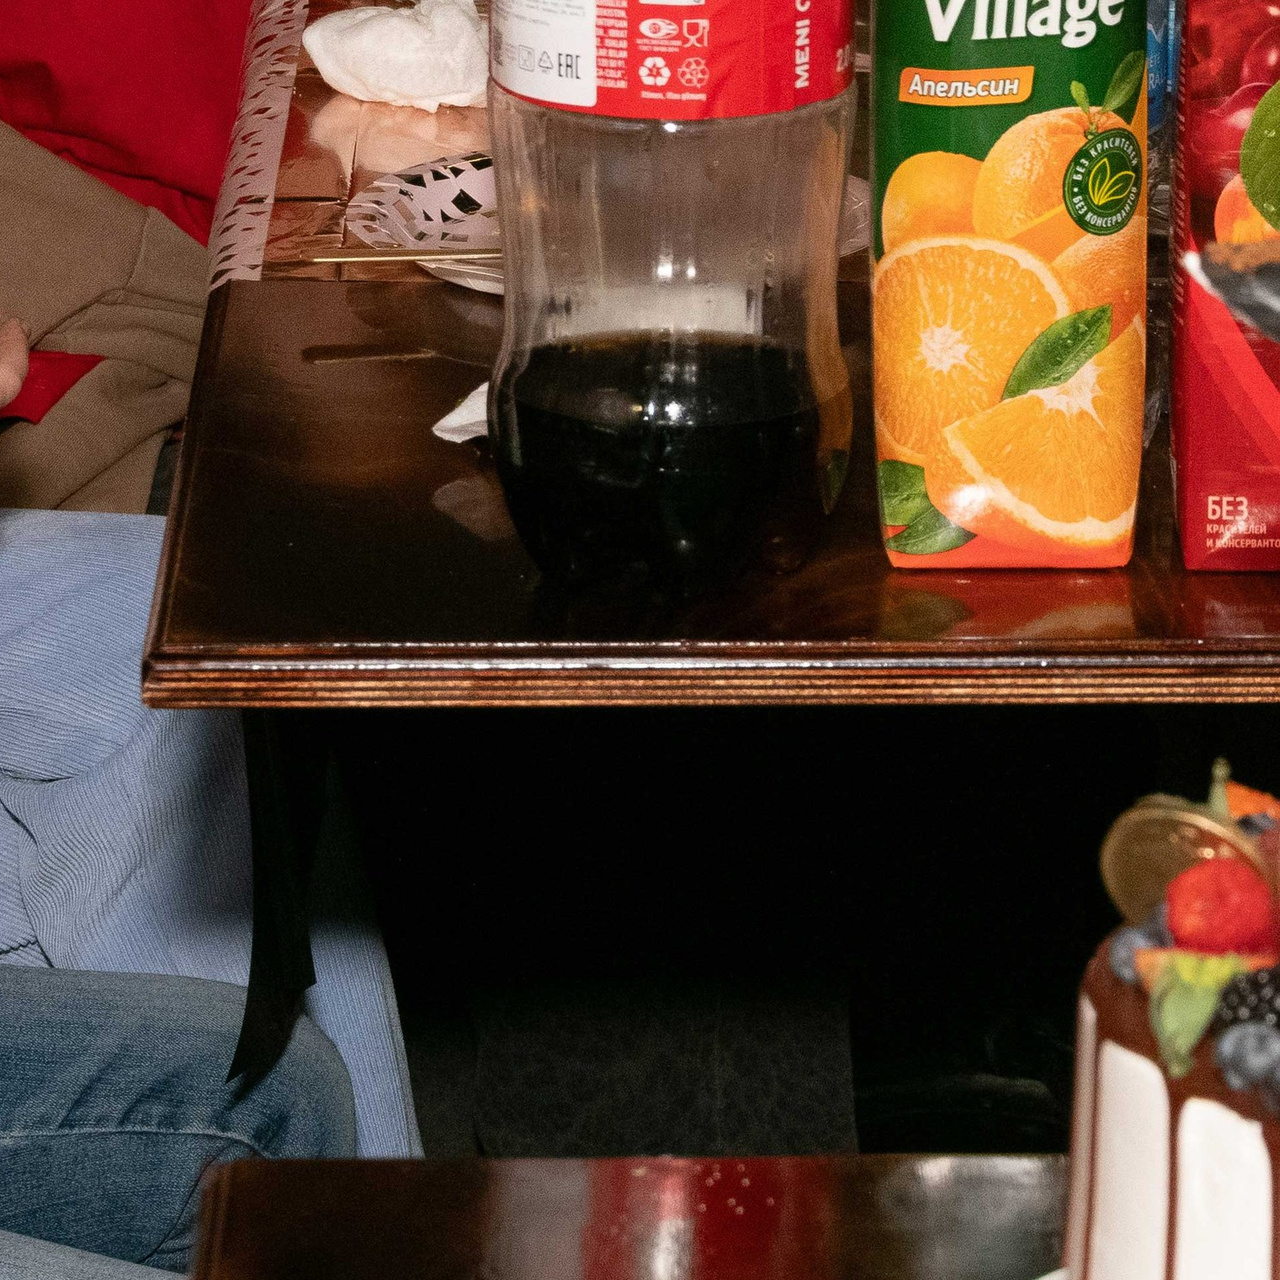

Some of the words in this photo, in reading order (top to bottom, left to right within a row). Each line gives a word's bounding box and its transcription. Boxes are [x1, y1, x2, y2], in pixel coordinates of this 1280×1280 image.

[795, 19, 810, 88] MENI
[908, 73, 1019, 97] Апельсин
[1072, 159, 1089, 180] БЕЗ
[1072, 195, 1087, 214] БЕЗ
[1084, 186, 1137, 227] КОНСЕРВАНТОВ
[1207, 495, 1249, 520] БЕЗ
[1206, 522, 1267, 535] КРАСИЕЛЕЙ
